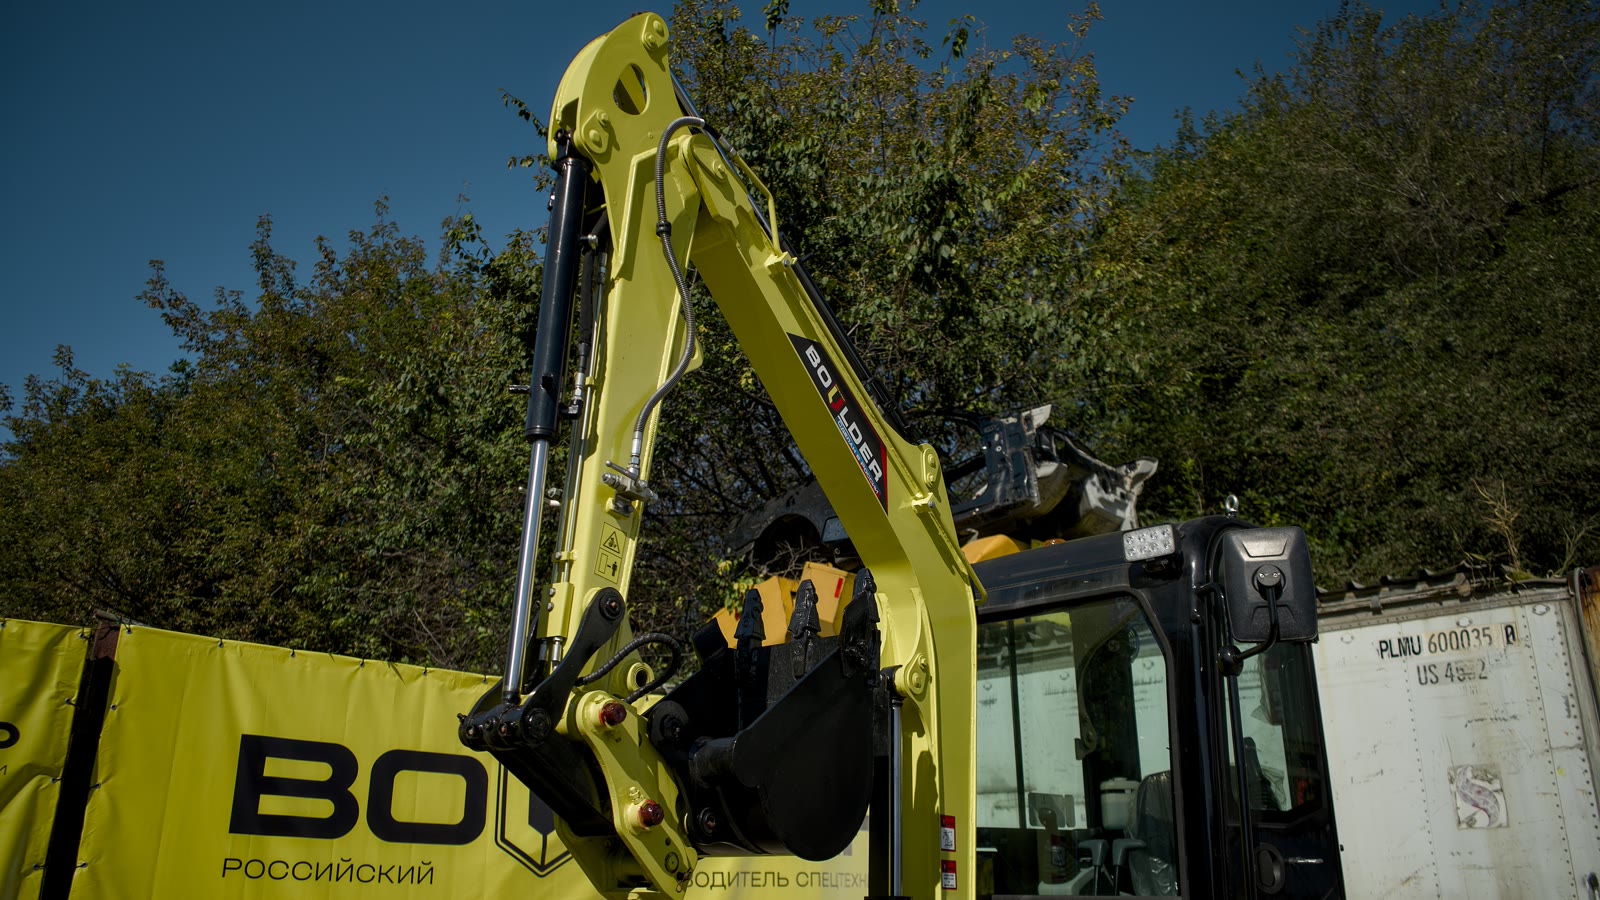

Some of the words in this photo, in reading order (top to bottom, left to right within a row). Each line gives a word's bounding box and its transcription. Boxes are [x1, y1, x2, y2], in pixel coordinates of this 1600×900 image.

[1379, 637, 1422, 659] PLMU
[1428, 627, 1492, 653] 600035
[1417, 664, 1439, 685] US
[222, 857, 434, 885] РОССИЙСКИЙ
